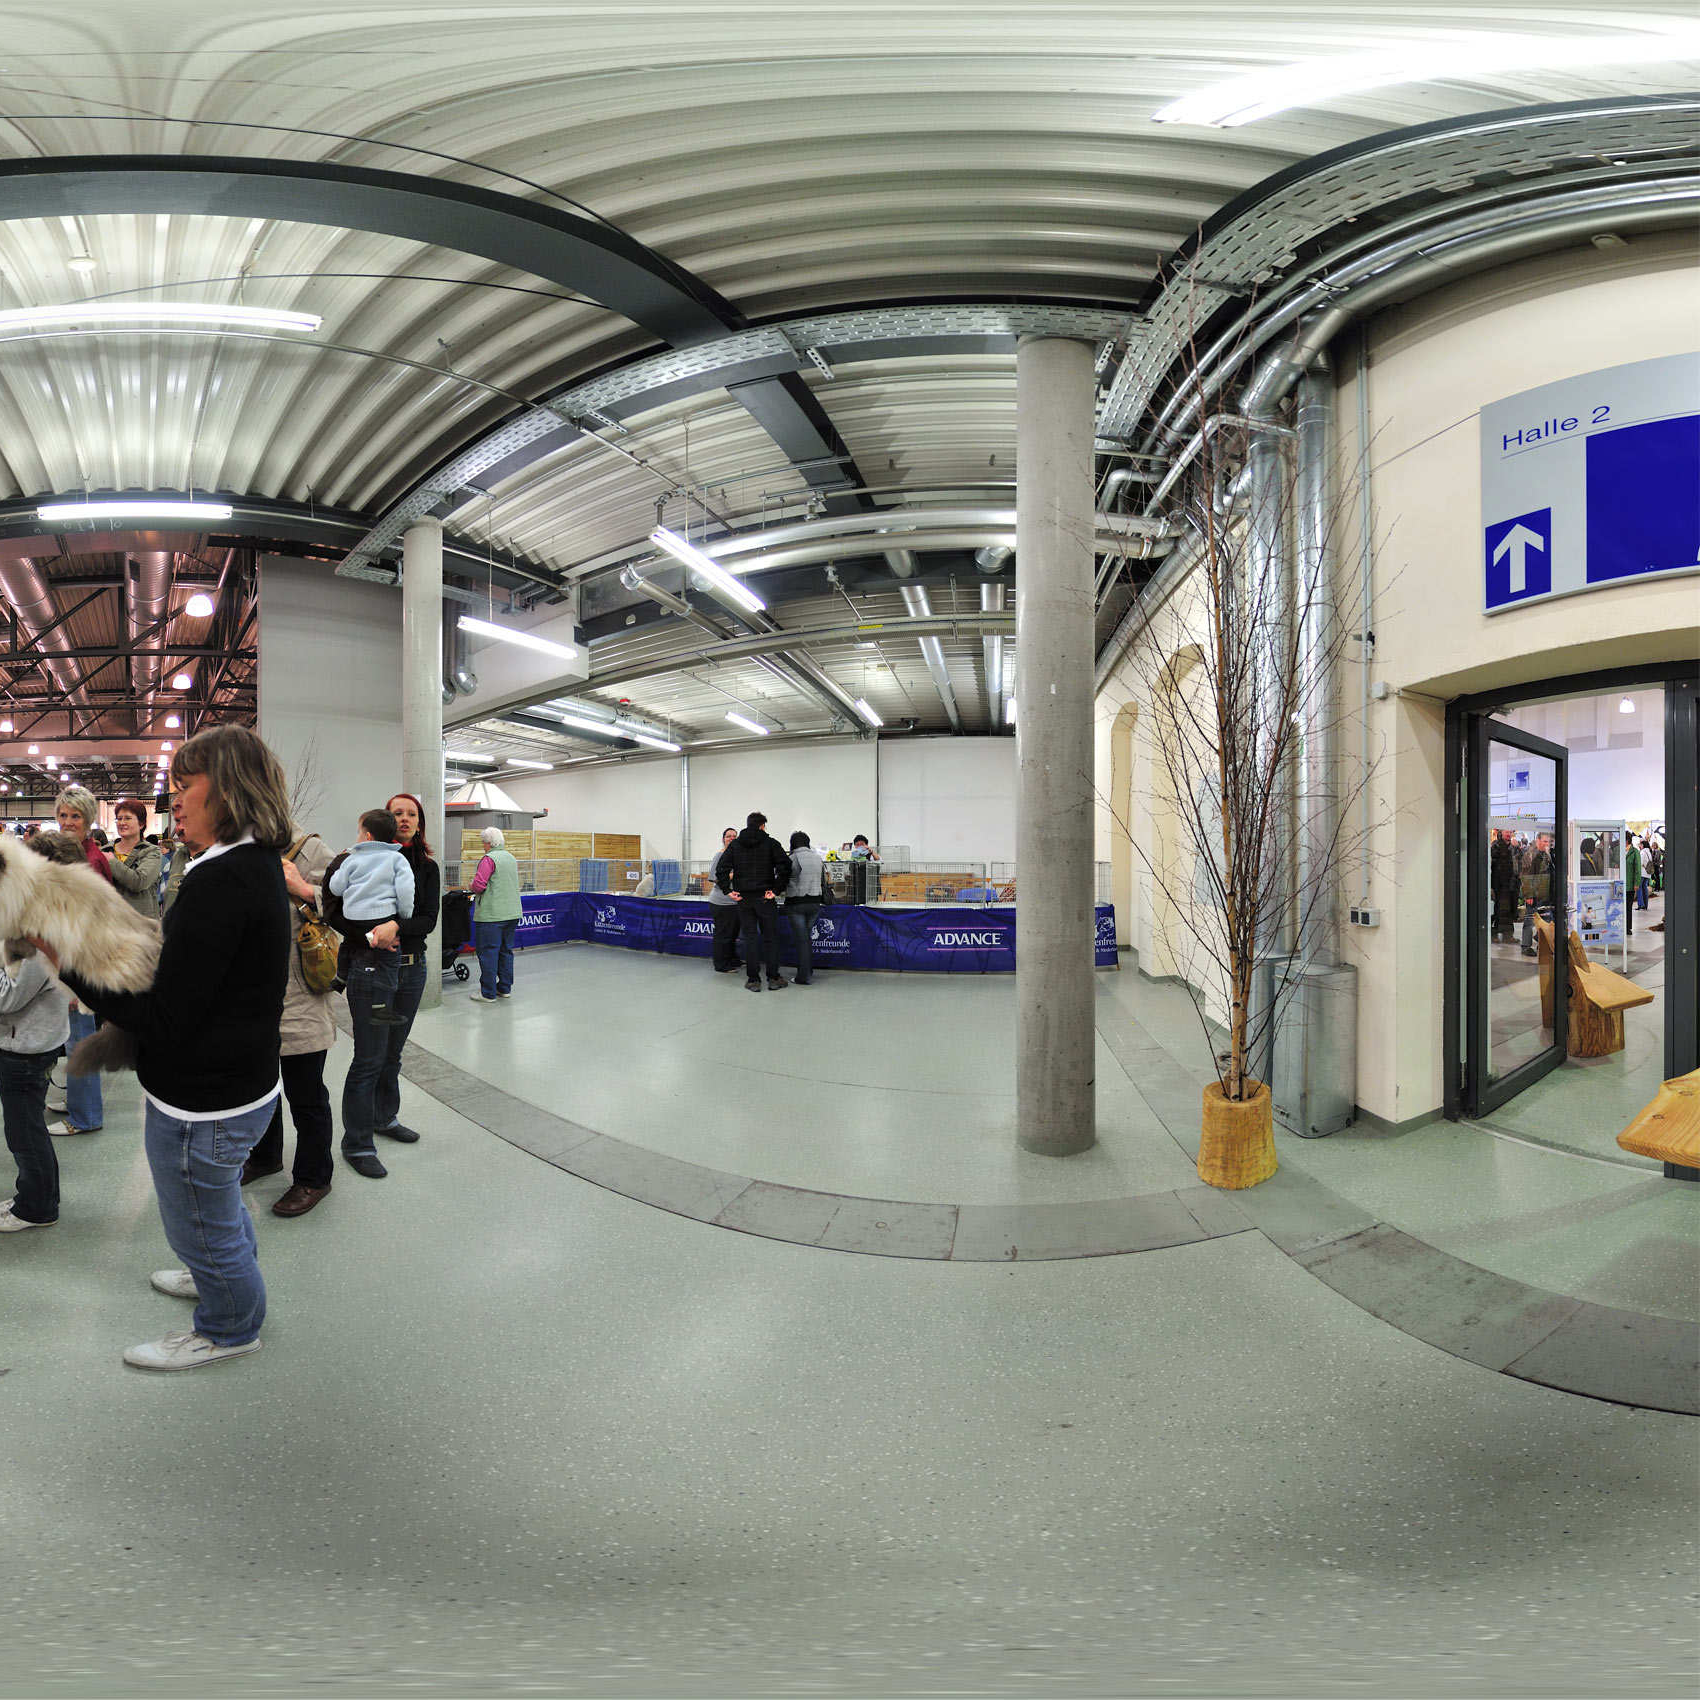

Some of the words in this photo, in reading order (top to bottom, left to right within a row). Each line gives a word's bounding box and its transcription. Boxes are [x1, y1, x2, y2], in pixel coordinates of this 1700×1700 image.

[1503, 417, 1579, 451] Halle
[1591, 405, 1611, 425] 2
[518, 913, 553, 928] DVANCE
[811, 938, 851, 948] zenfreunde
[933, 932, 1002, 946] ADVANCE
